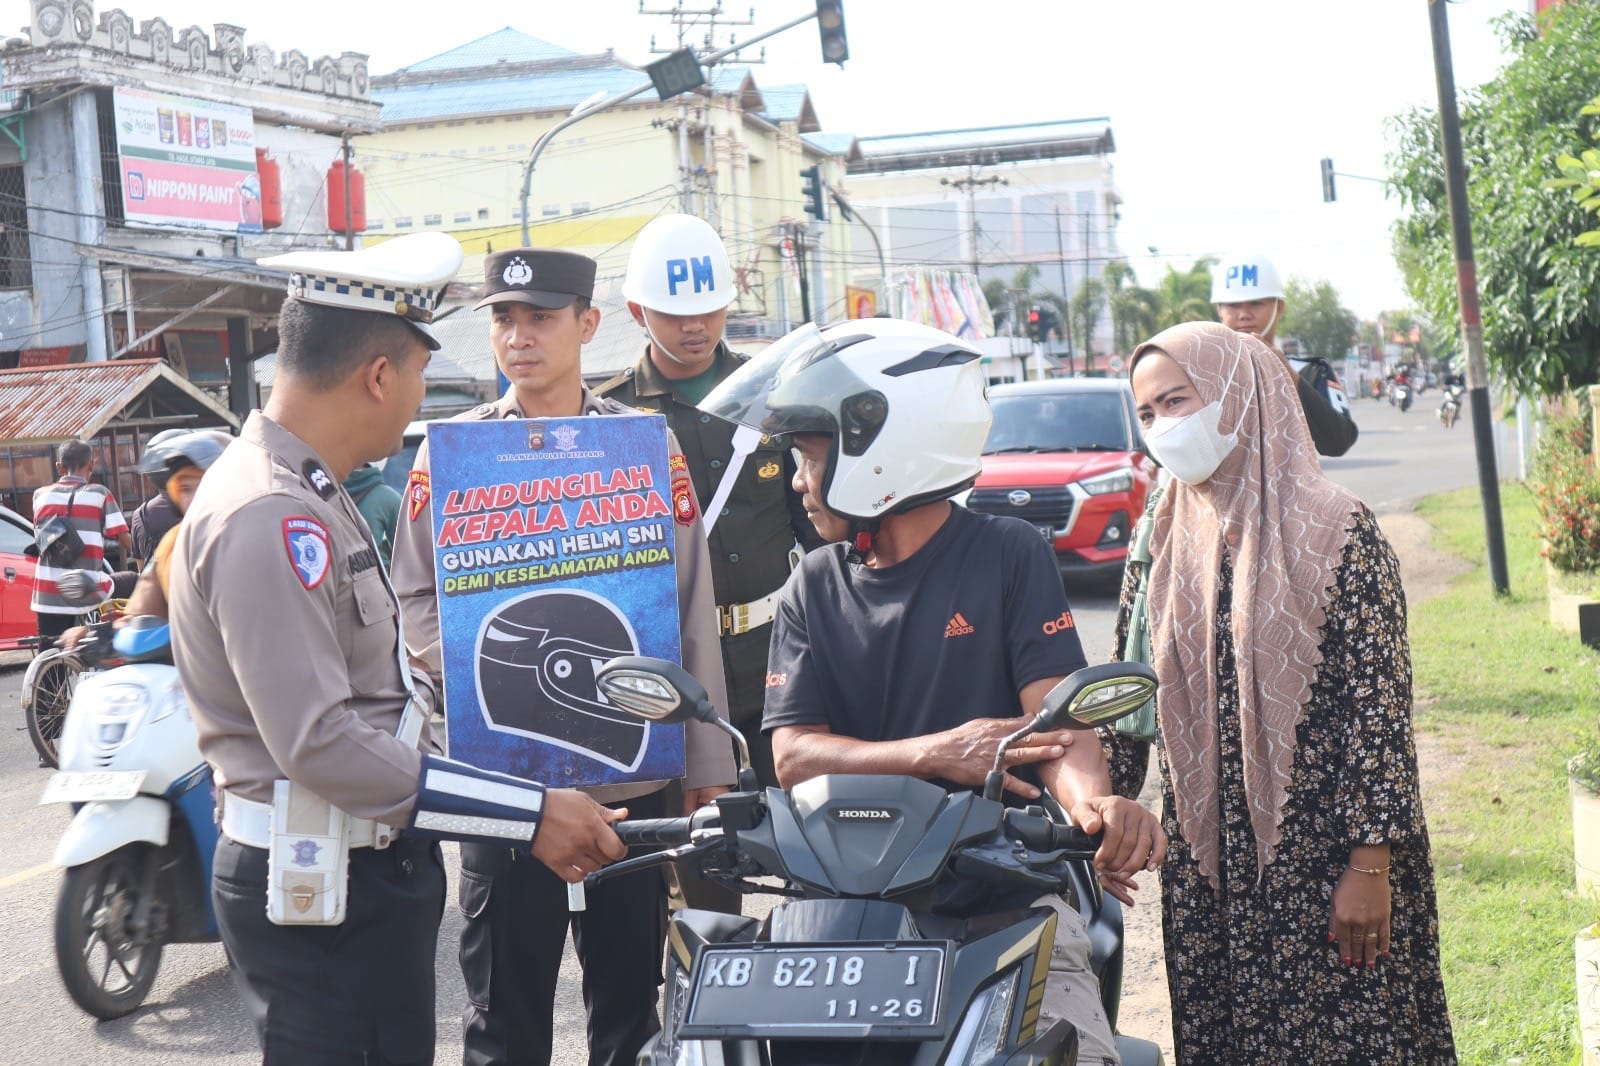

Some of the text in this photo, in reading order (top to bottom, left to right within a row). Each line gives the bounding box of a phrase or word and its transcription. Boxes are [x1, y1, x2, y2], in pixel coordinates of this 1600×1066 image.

[147, 178, 236, 205] NIPPON PAINT
[666, 255, 715, 296] PM
[1226, 264, 1258, 289] PM
[442, 465, 653, 515] LINDUNGILAH
[437, 491, 670, 546] KEPALA ANDA
[442, 523, 663, 570] GUNAKAN HELM SNI
[444, 547, 670, 593] DEMI KESELAMATAN ANDA
[944, 625, 975, 638] adidas
[838, 810, 891, 818] HONDA
[704, 955, 920, 987] KB 6218 I
